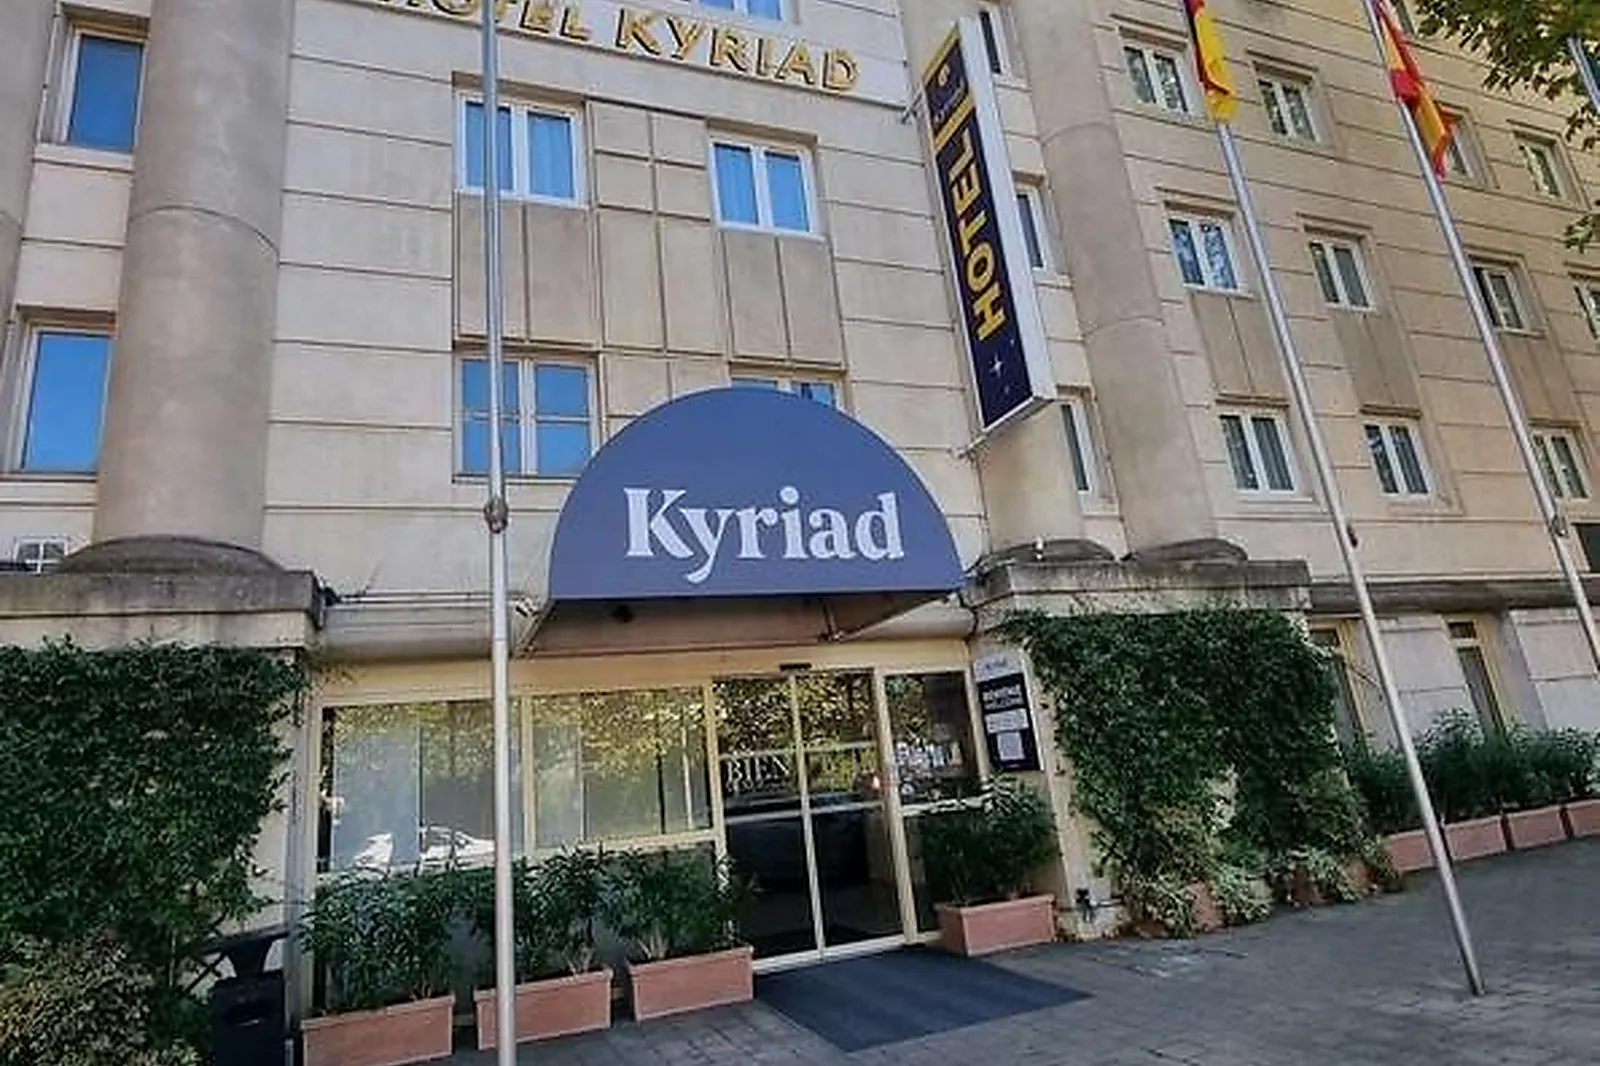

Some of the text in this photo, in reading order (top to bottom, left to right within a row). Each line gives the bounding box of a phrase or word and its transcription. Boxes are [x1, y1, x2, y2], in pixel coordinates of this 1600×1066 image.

[614, 8, 861, 91] KYRIAD
[949, 128, 1005, 340] HOTEL
[624, 486, 905, 583] Kyriad
